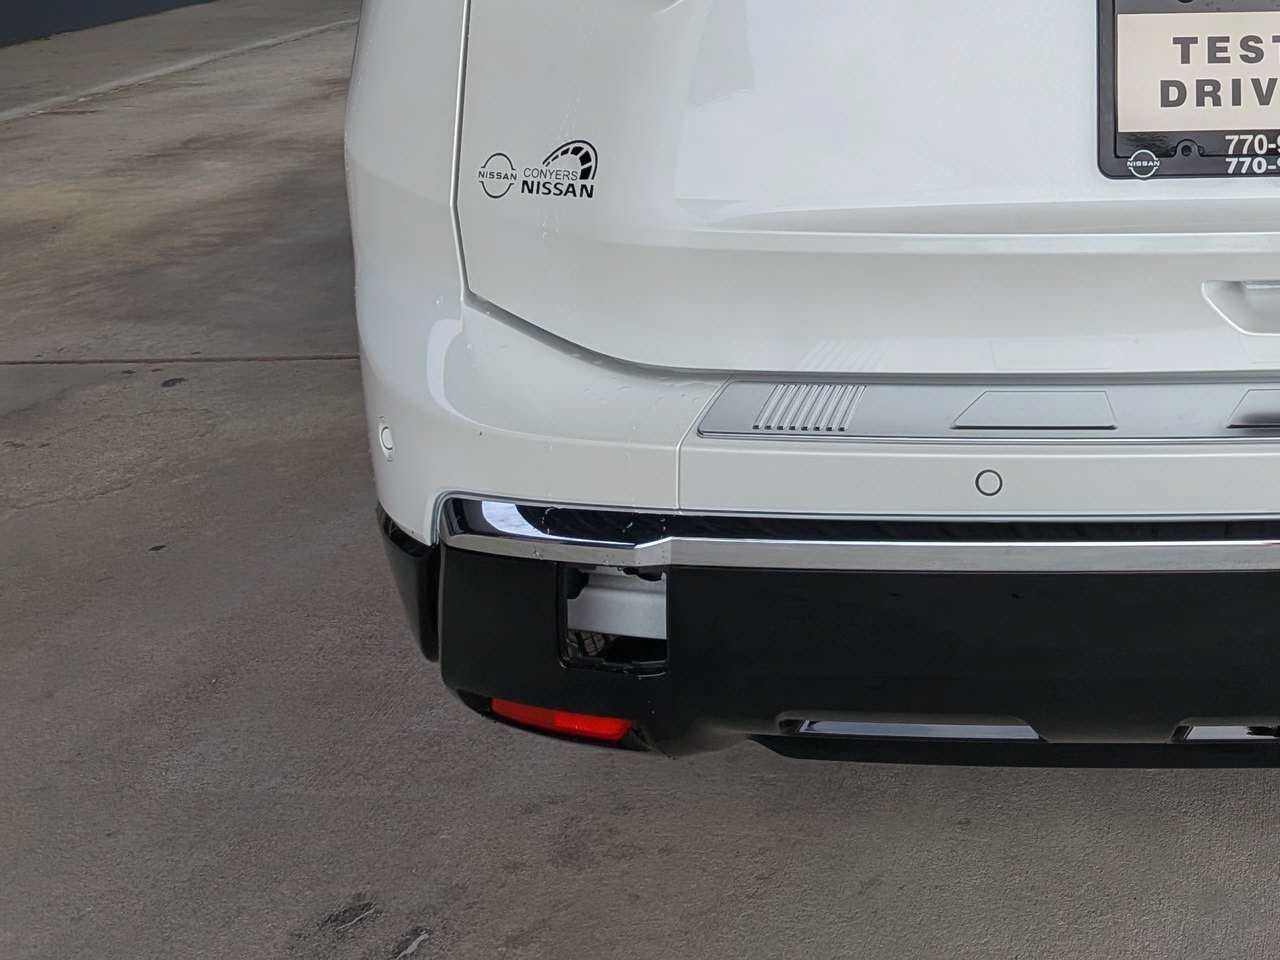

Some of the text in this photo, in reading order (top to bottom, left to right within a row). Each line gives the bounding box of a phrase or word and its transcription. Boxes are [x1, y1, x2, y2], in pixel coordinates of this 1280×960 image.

[478, 170, 518, 180] NISSAN
[523, 167, 578, 181] CONYERS
[521, 179, 594, 198] NISSAN
